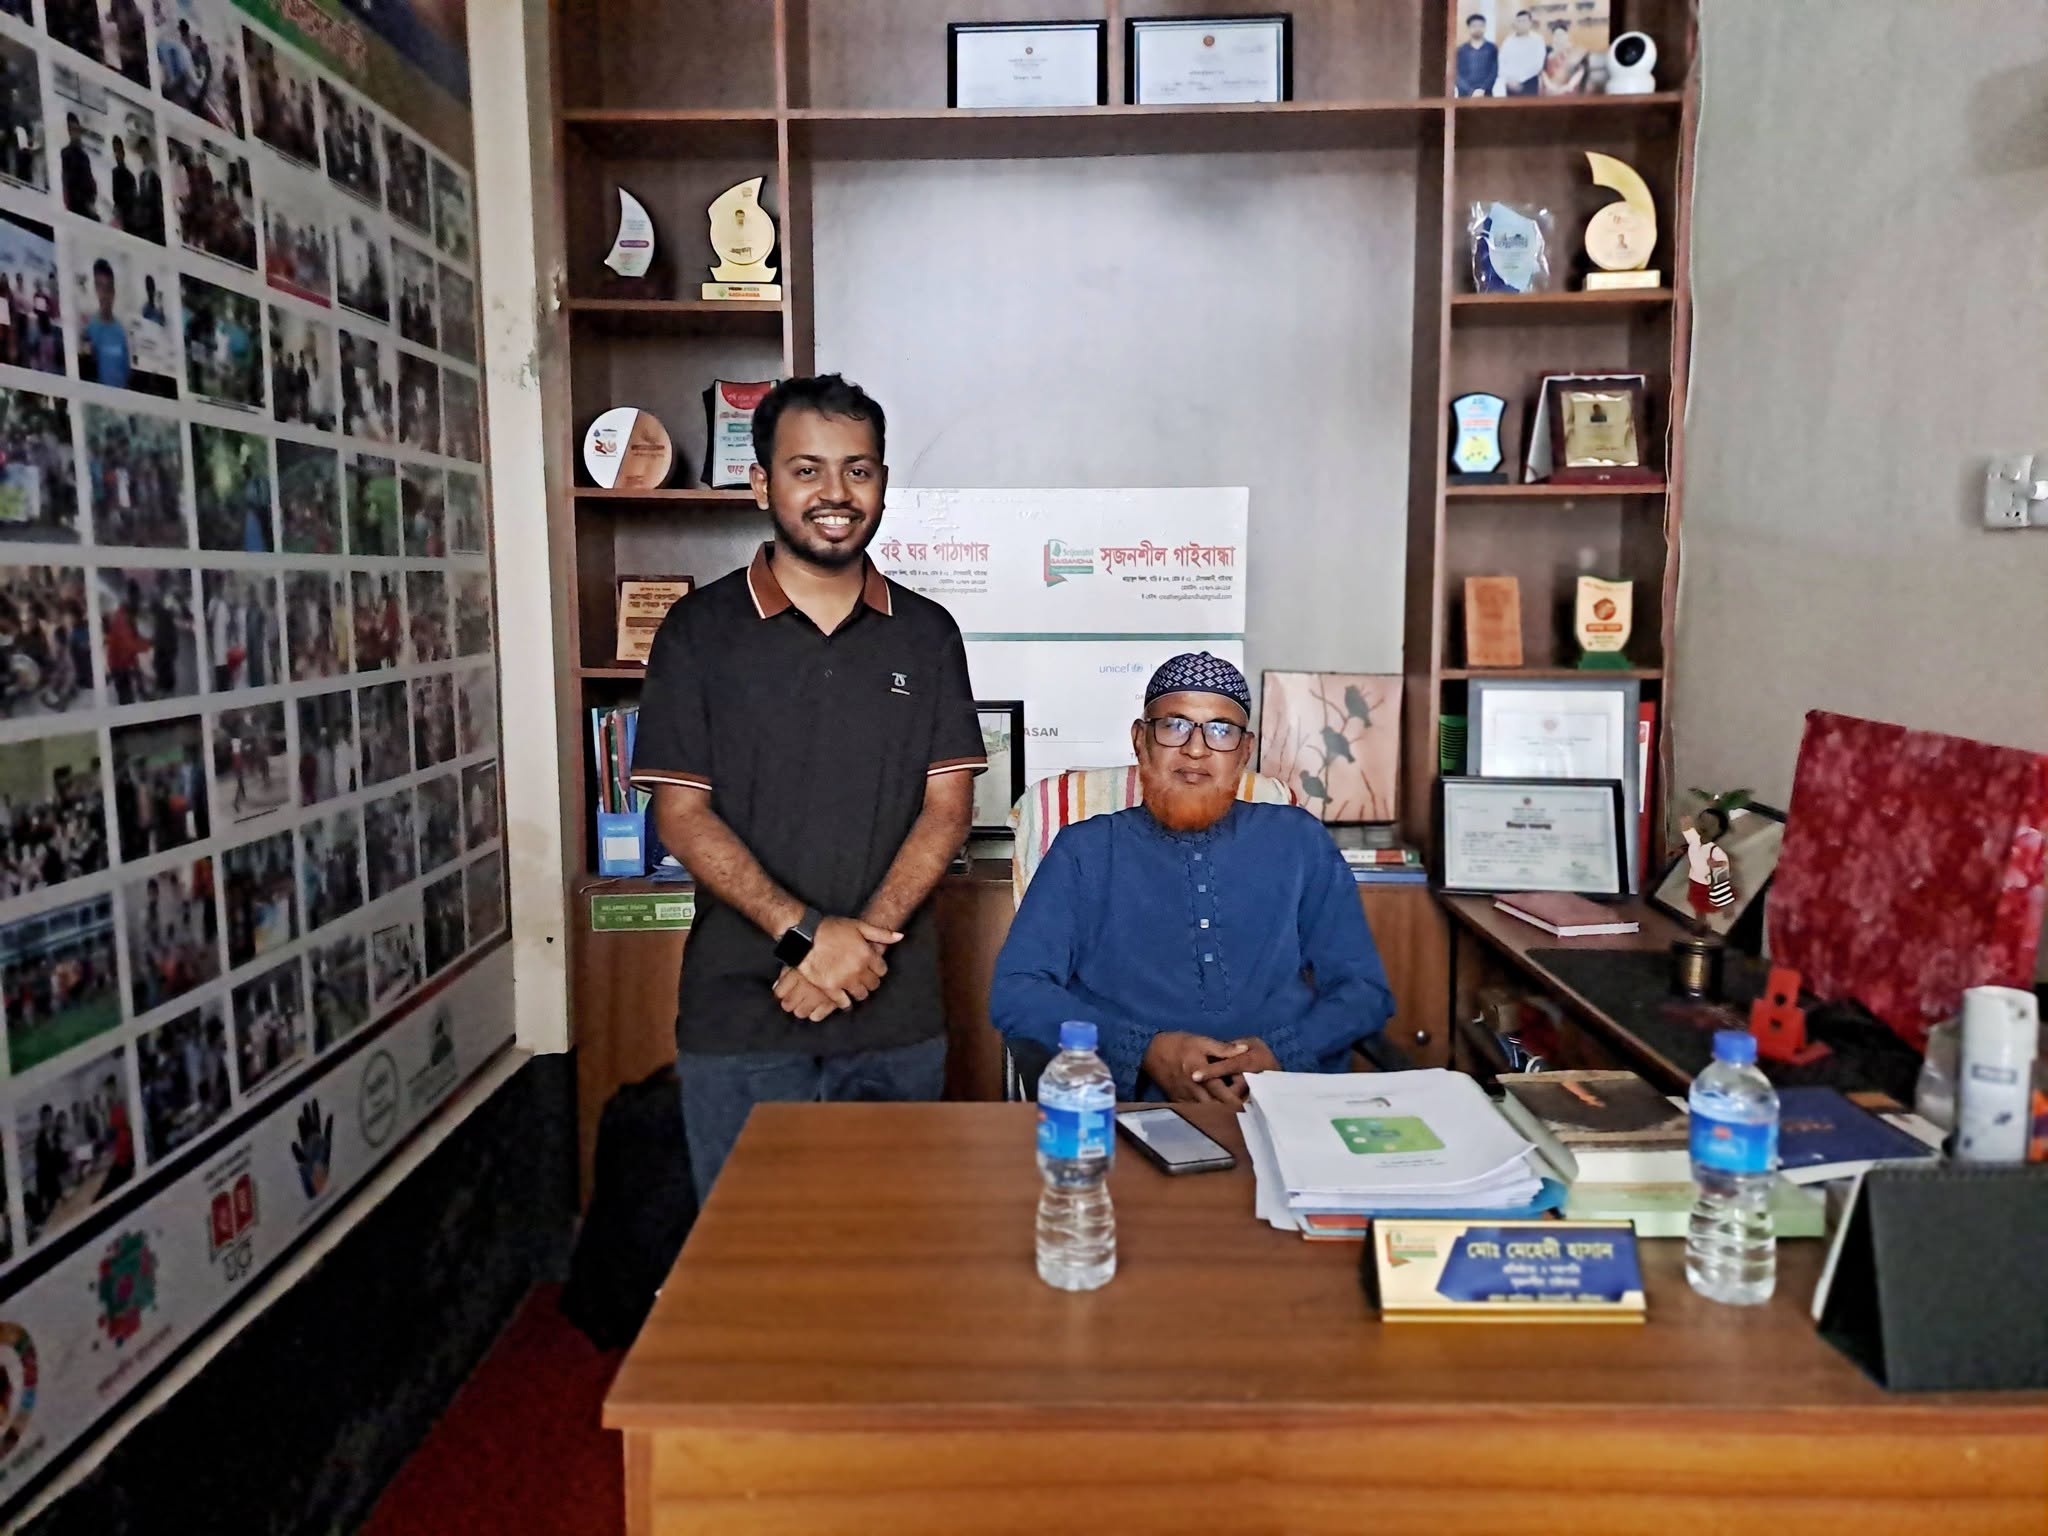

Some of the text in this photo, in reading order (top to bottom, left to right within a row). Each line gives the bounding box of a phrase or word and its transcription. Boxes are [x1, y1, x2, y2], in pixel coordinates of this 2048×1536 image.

[879, 536, 990, 562] বই ঘর পাঠাগার
[1100, 540, 1236, 575] সৃজনশীল গাইবান্ধা
[1099, 662, 1130, 673] unicef
[1023, 727, 1059, 737] ASAN
